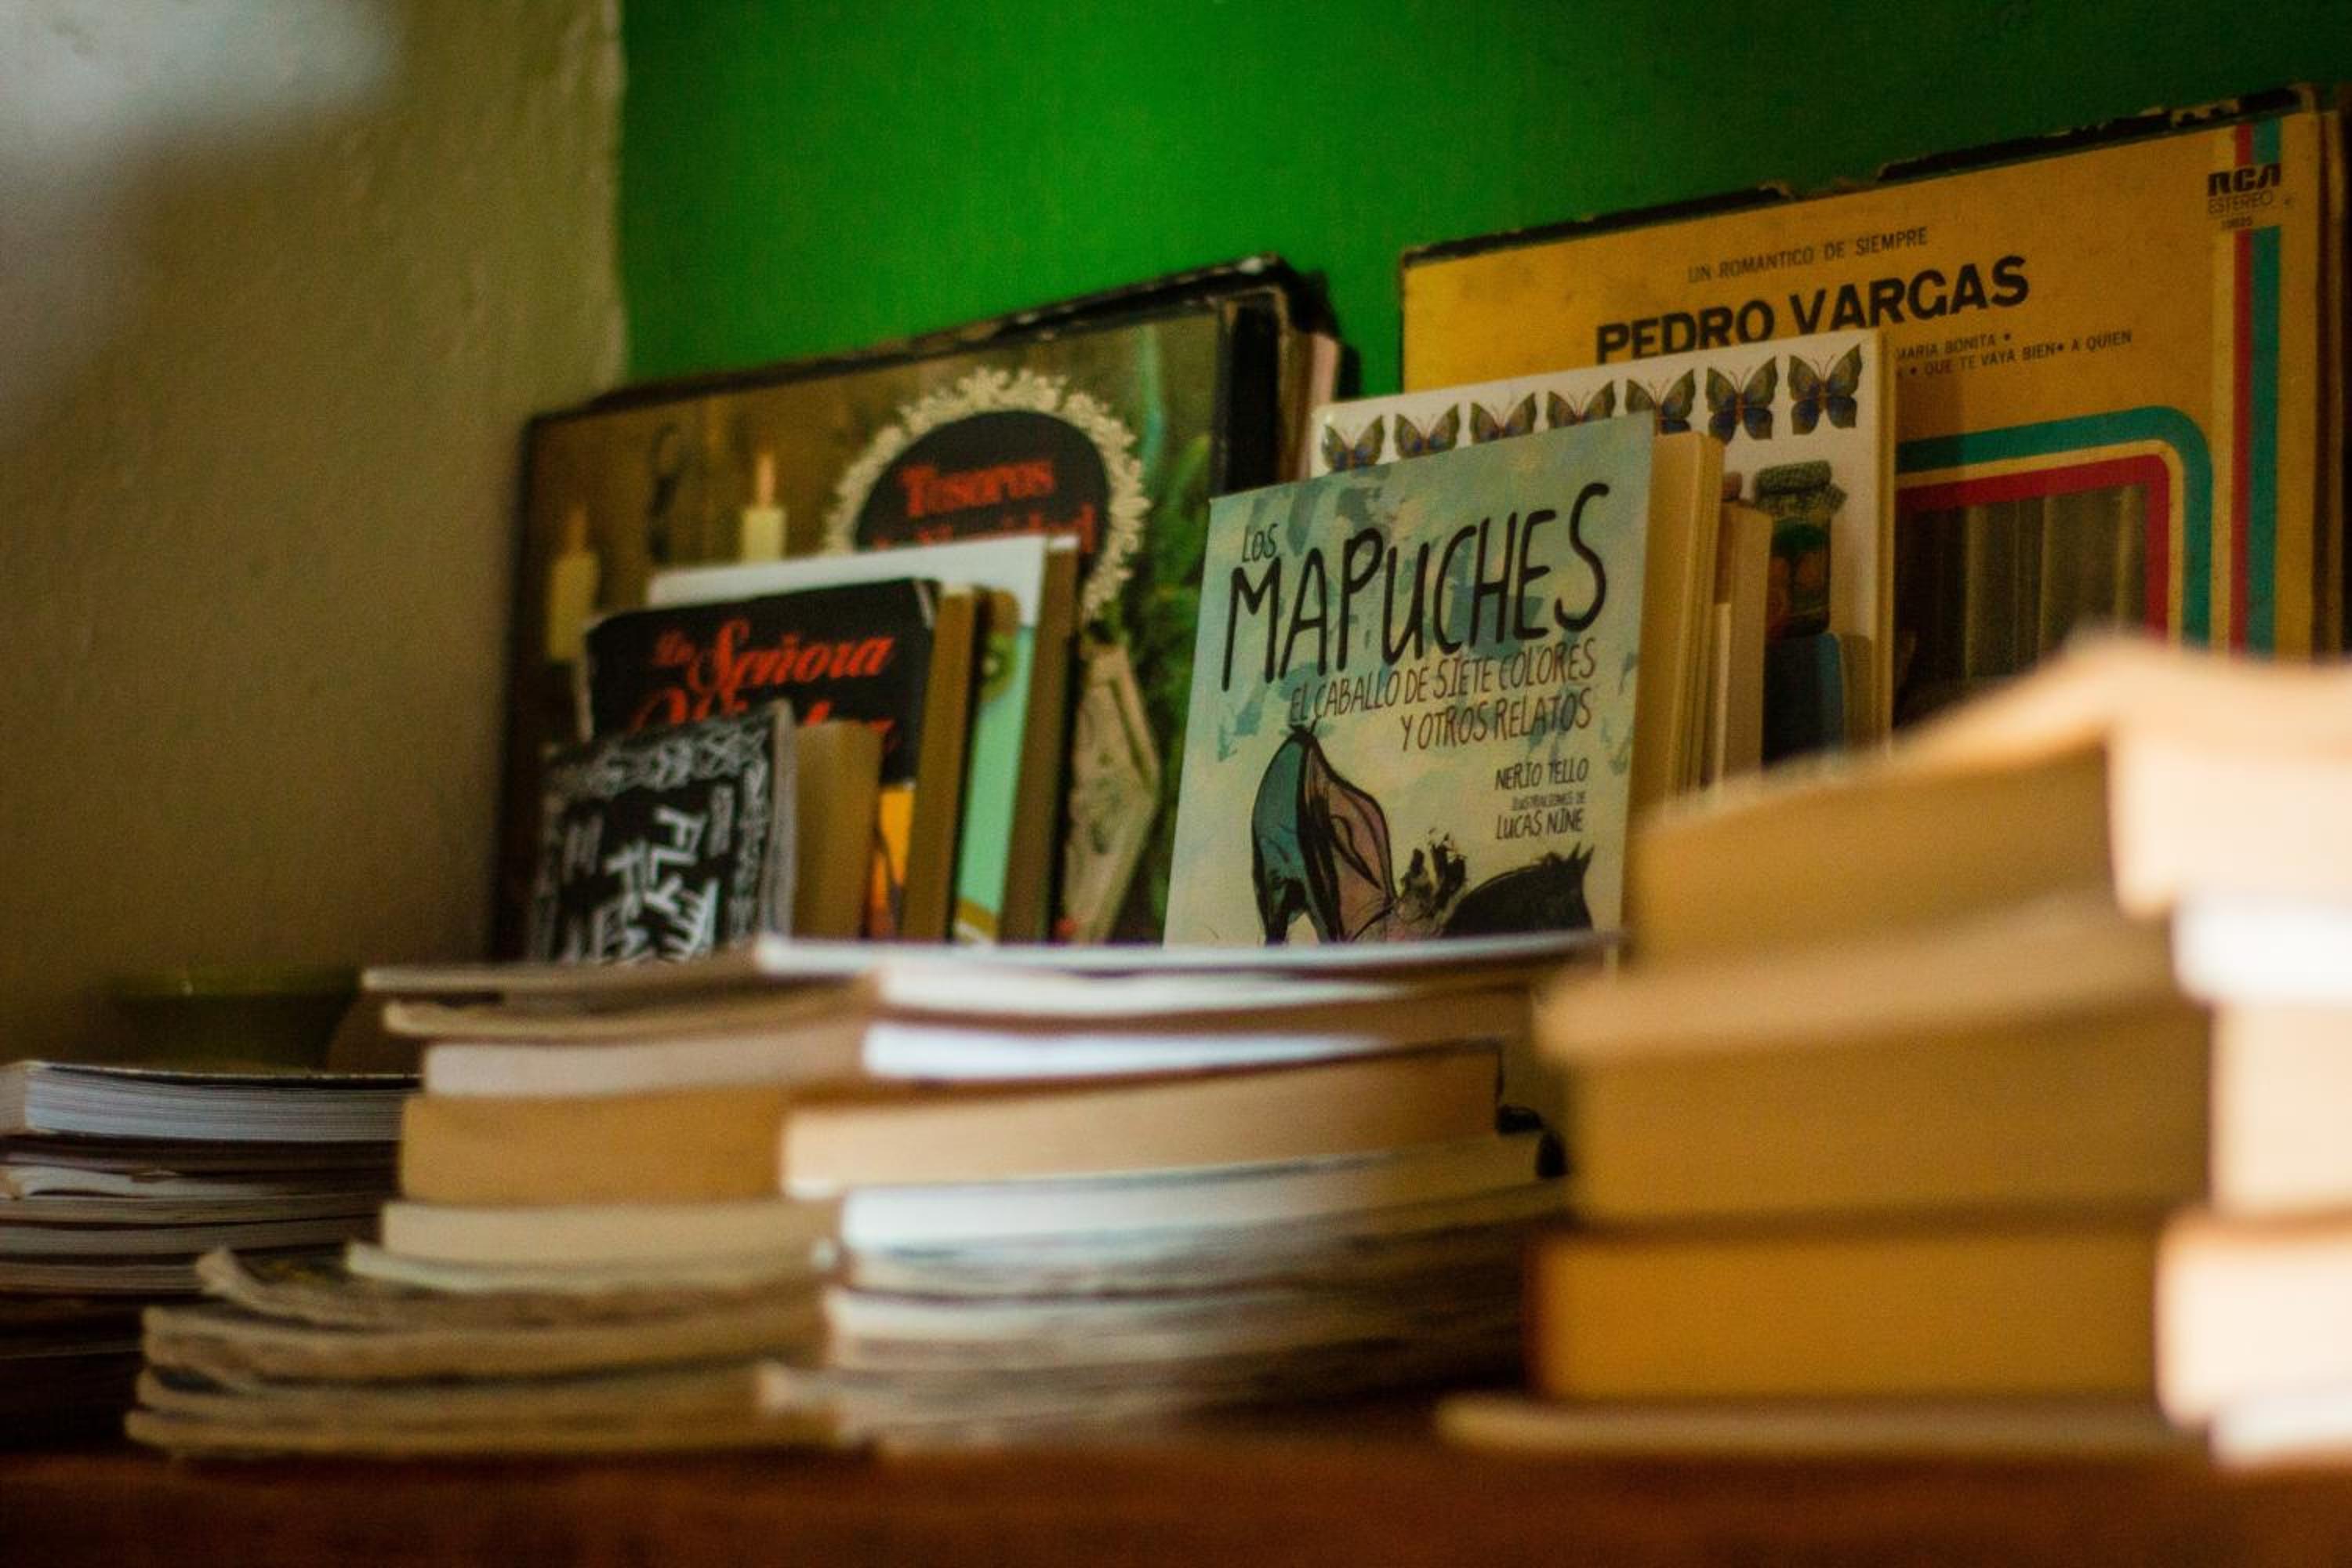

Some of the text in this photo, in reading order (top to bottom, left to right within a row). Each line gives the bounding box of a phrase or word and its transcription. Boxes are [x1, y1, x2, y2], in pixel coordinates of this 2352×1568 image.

[2207, 162, 2281, 197] RCA
[1688, 226, 1928, 283] UN ROMANTICO DE SIEMPRE
[1596, 255, 2030, 365] PEDRO VARGAS
[1924, 358, 1953, 377] QUE
[1960, 354, 1976, 371] TE
[1980, 347, 2016, 366] VAYA
[2071, 339, 2080, 352] A
[2085, 329, 2132, 352] QUIEN
[1944, 332, 1996, 354] BONITA
[1241, 522, 1278, 564] LOS
[1221, 481, 1610, 691] MAPUCHES
[1290, 636, 1596, 723] EL CABALLO DE SIETE COLORES
[1400, 686, 1592, 752] Y OTROS RELATOS
[1494, 757, 1590, 791] NERIO TELLO
[1496, 807, 1584, 840] LUCAS NINE
